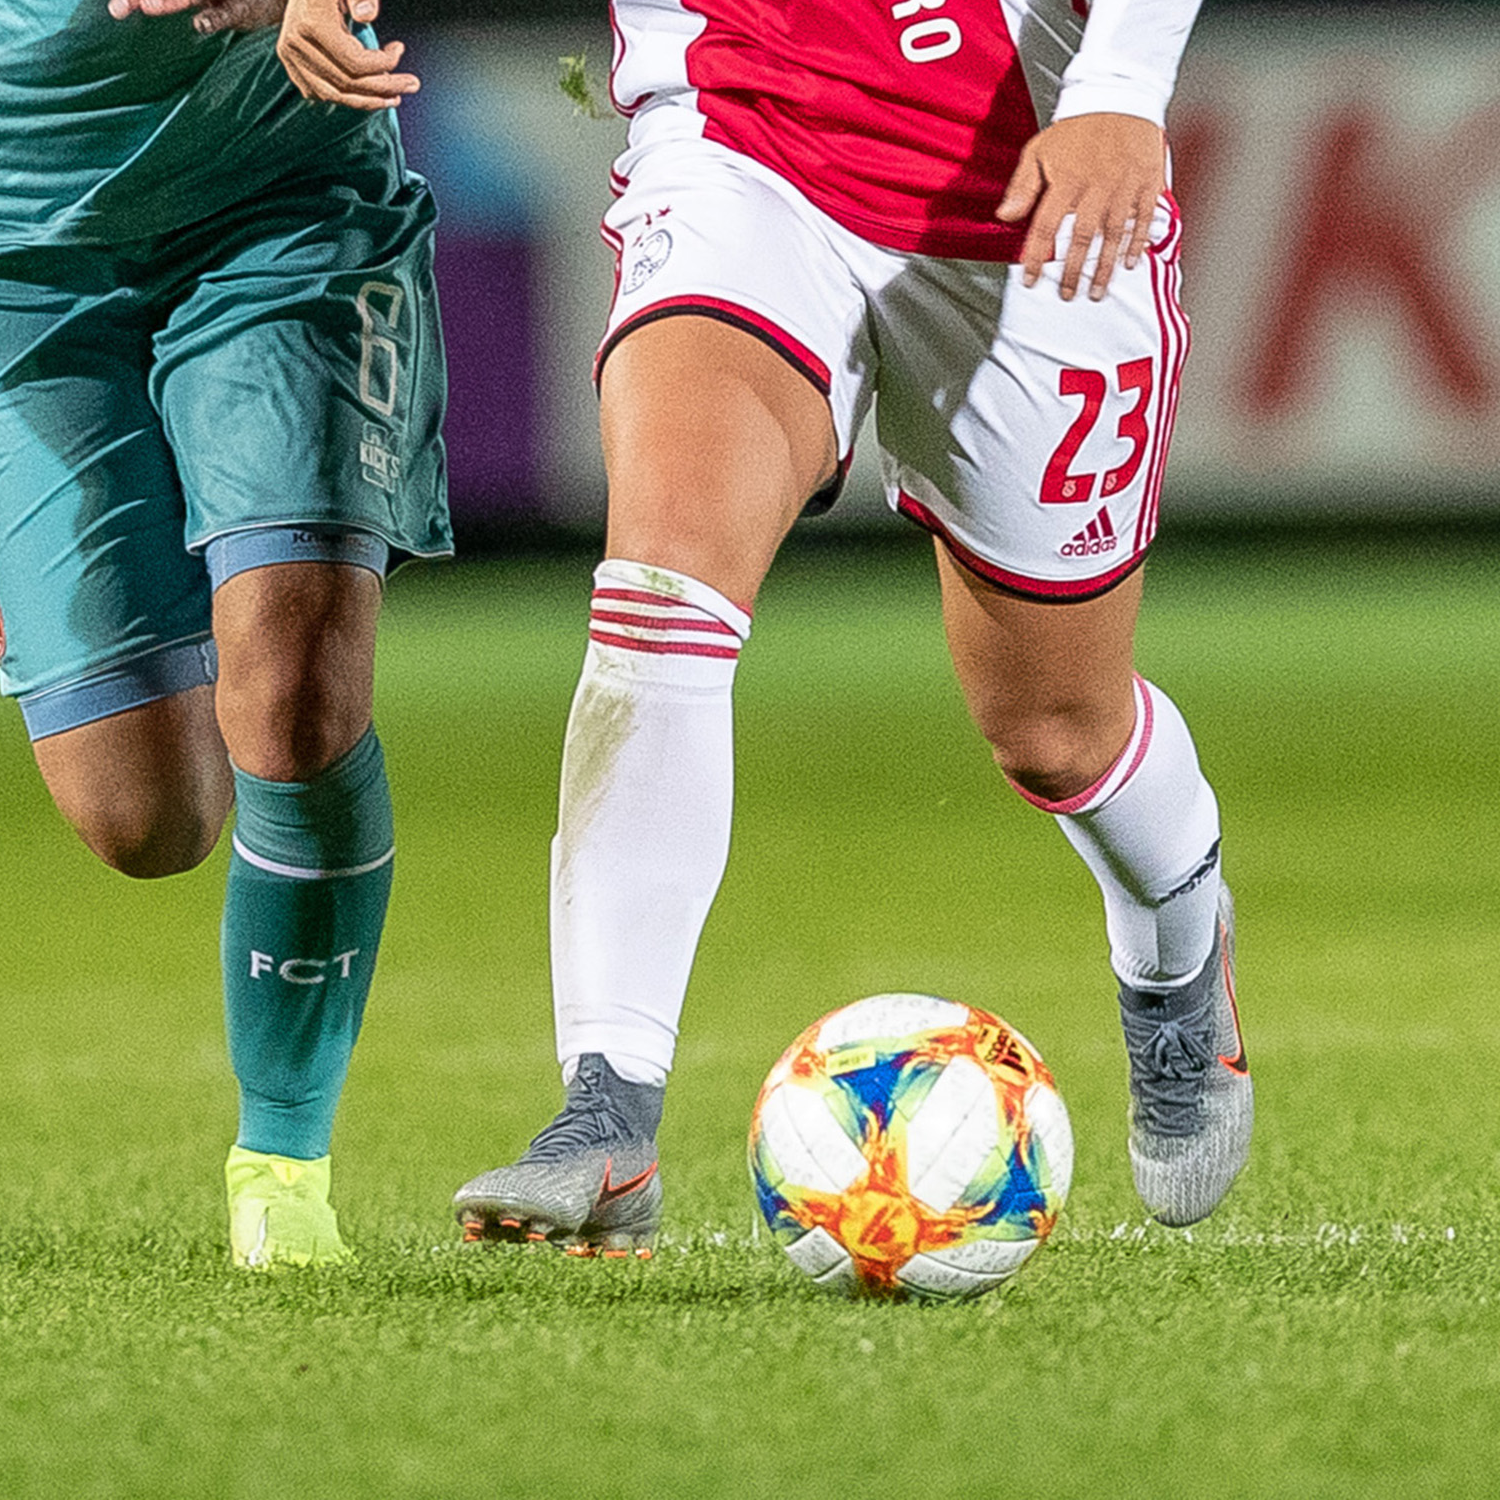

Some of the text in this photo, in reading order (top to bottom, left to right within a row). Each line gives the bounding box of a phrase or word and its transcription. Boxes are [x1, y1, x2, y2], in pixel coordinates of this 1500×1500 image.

[357, 281, 404, 417] 8
[1039, 356, 1153, 504] 23
[1060, 536, 1118, 557] adidas
[250, 948, 361, 985] FCT
